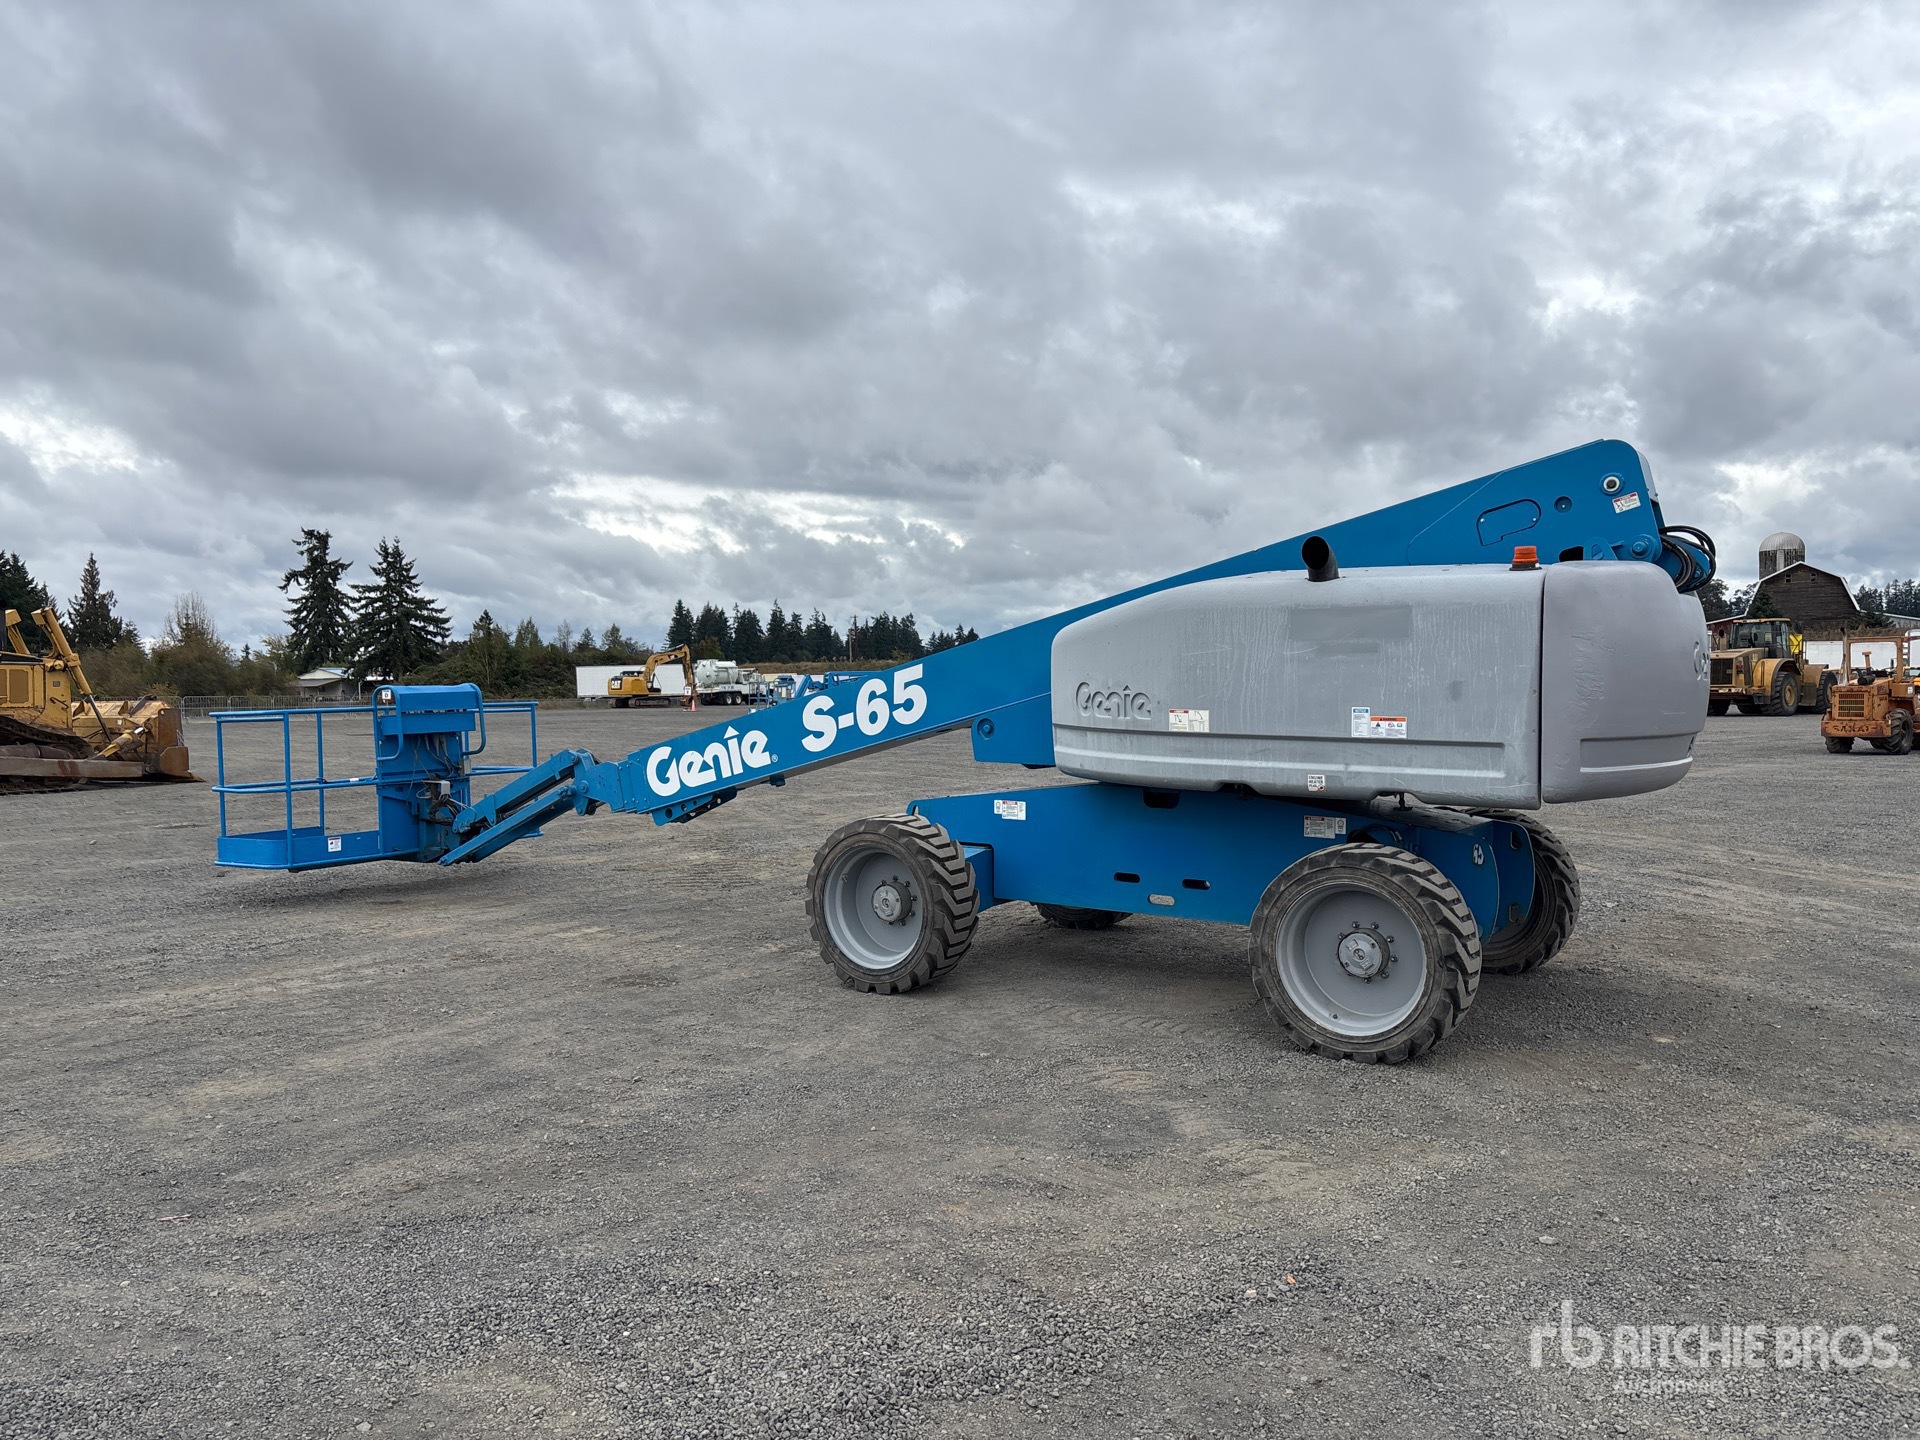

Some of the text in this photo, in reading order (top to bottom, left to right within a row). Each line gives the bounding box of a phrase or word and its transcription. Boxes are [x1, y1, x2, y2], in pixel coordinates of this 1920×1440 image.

[801, 663, 928, 752] S-65
[1075, 681, 1152, 721] Genie
[646, 725, 772, 797] Genie
